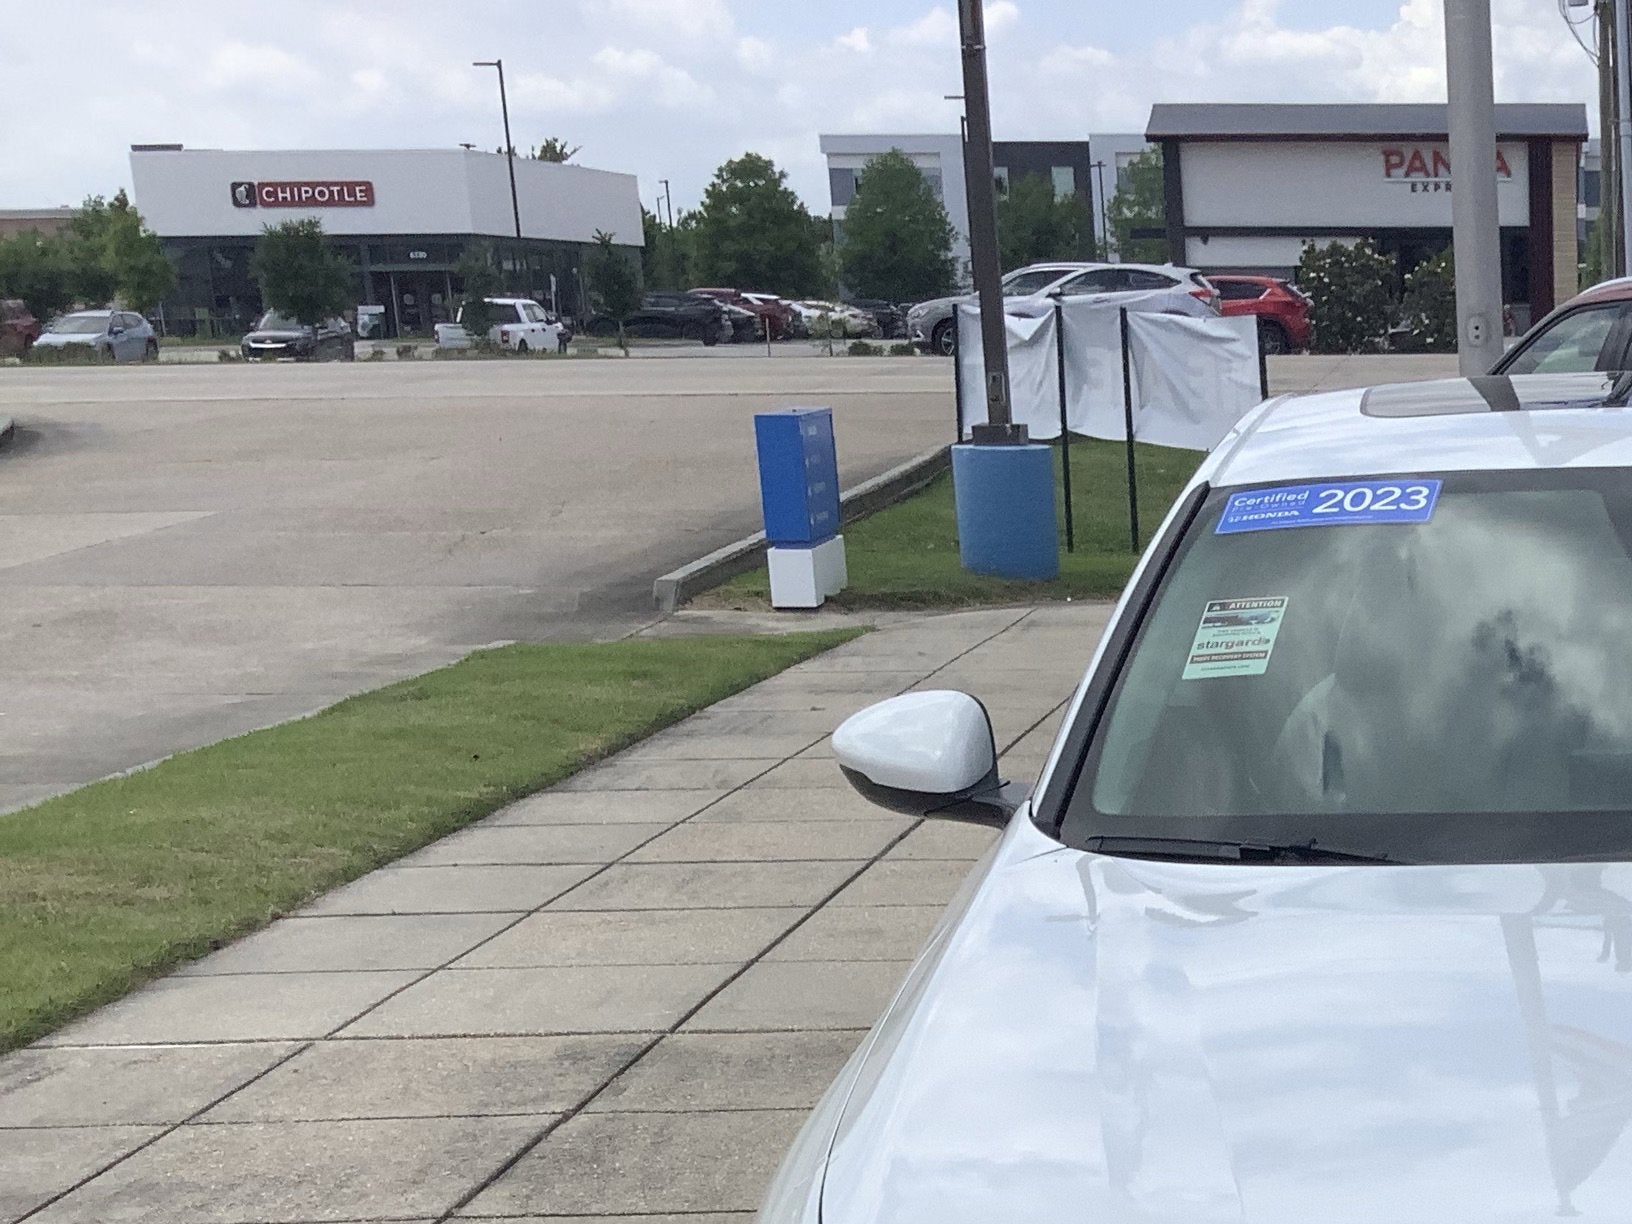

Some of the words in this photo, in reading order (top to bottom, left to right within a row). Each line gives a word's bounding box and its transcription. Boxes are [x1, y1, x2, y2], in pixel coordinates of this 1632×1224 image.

[1381, 148, 1512, 178] PANA
[262, 185, 368, 202] CHIPOTLE
[1234, 490, 1310, 507] Certified
[1312, 485, 1431, 514] 2023
[1241, 510, 1300, 521] HONDA
[1228, 600, 1283, 609] ATTENTION
